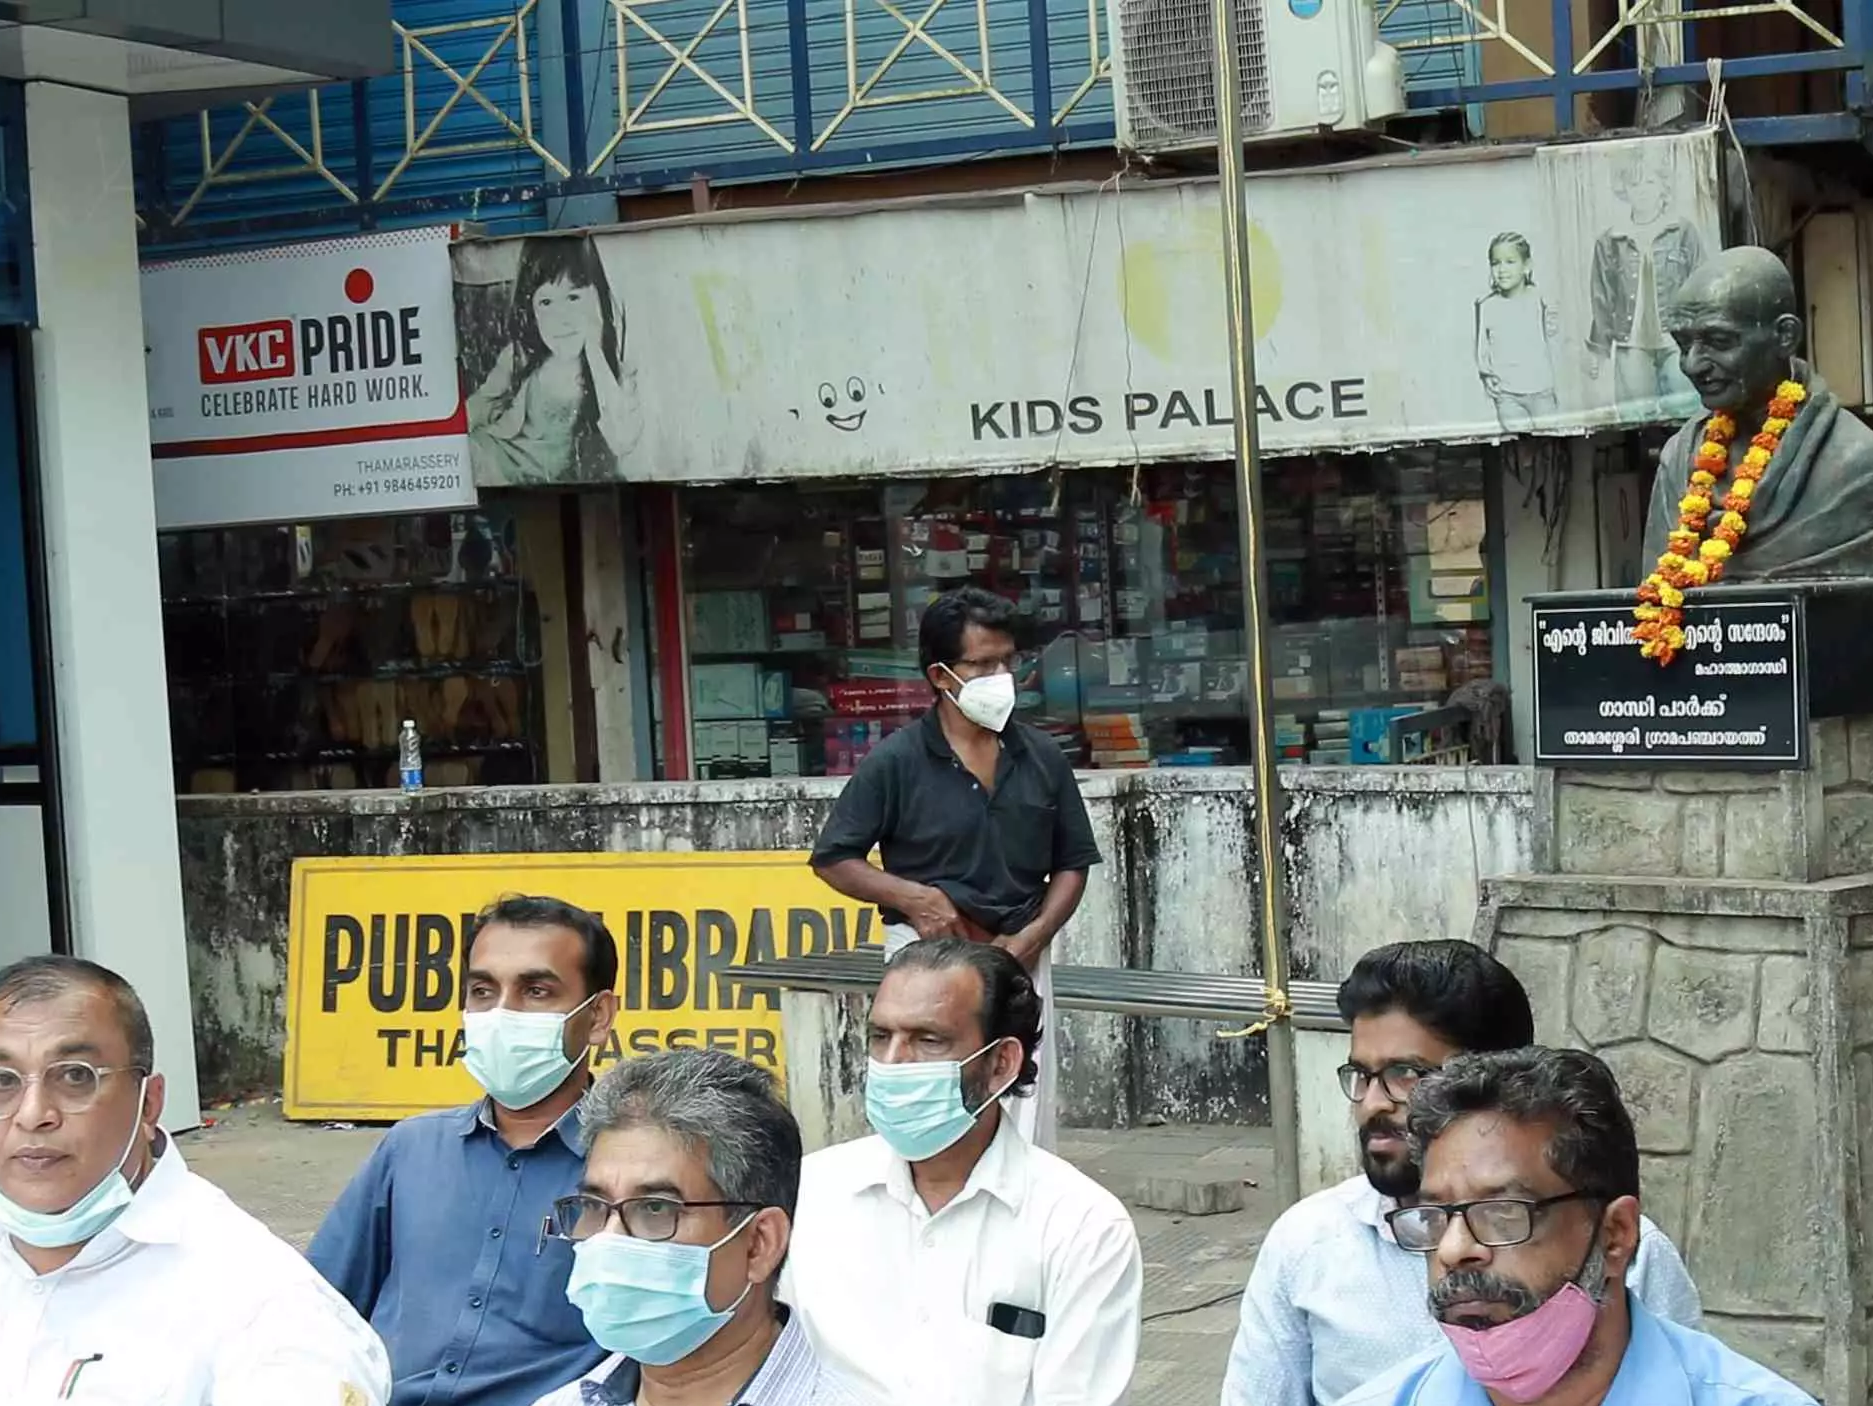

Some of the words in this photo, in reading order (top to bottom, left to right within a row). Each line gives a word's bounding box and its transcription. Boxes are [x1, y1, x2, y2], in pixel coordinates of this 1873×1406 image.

[205, 329, 286, 375] VKC
[300, 306, 423, 377] PRIDE
[200, 385, 300, 417] CELEBRATE
[307, 380, 357, 409] HARD
[365, 374, 429, 402] WORK.
[971, 395, 1103, 441] KIDS
[1124, 378, 1368, 431] PALACE
[356, 452, 461, 475] THAMARASSERY
[357, 480, 381, 496] +91
[383, 474, 462, 494] 9846459201
[1598, 694, 1656, 718] ഗാന്ധി
[1658, 692, 1728, 718] പാർക്ക്
[1563, 726, 1641, 754] താമരശ്ശേരി
